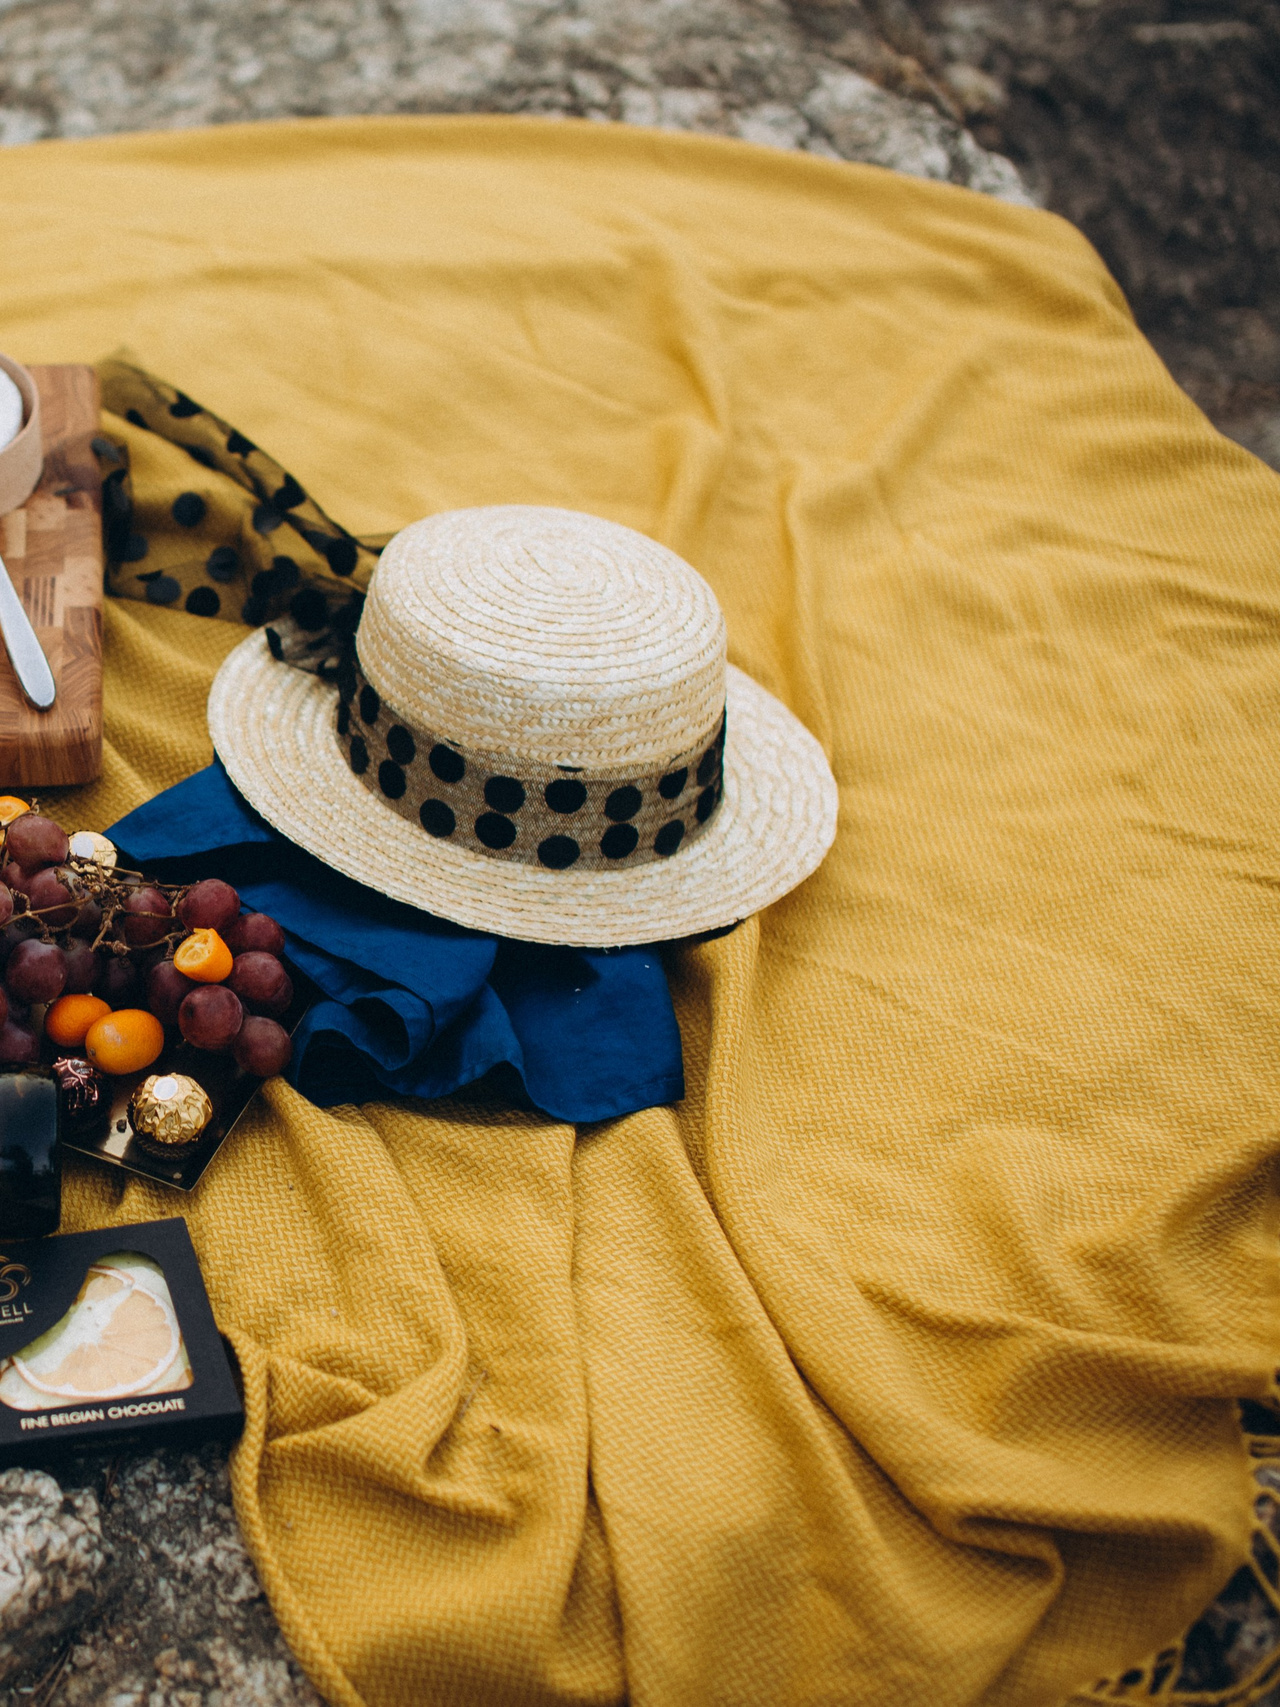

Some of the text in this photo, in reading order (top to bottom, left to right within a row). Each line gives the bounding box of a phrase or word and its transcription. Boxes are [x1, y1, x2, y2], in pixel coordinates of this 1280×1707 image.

[20, 1397, 186, 1431] FINE BELGIAN CHOCOLATE
